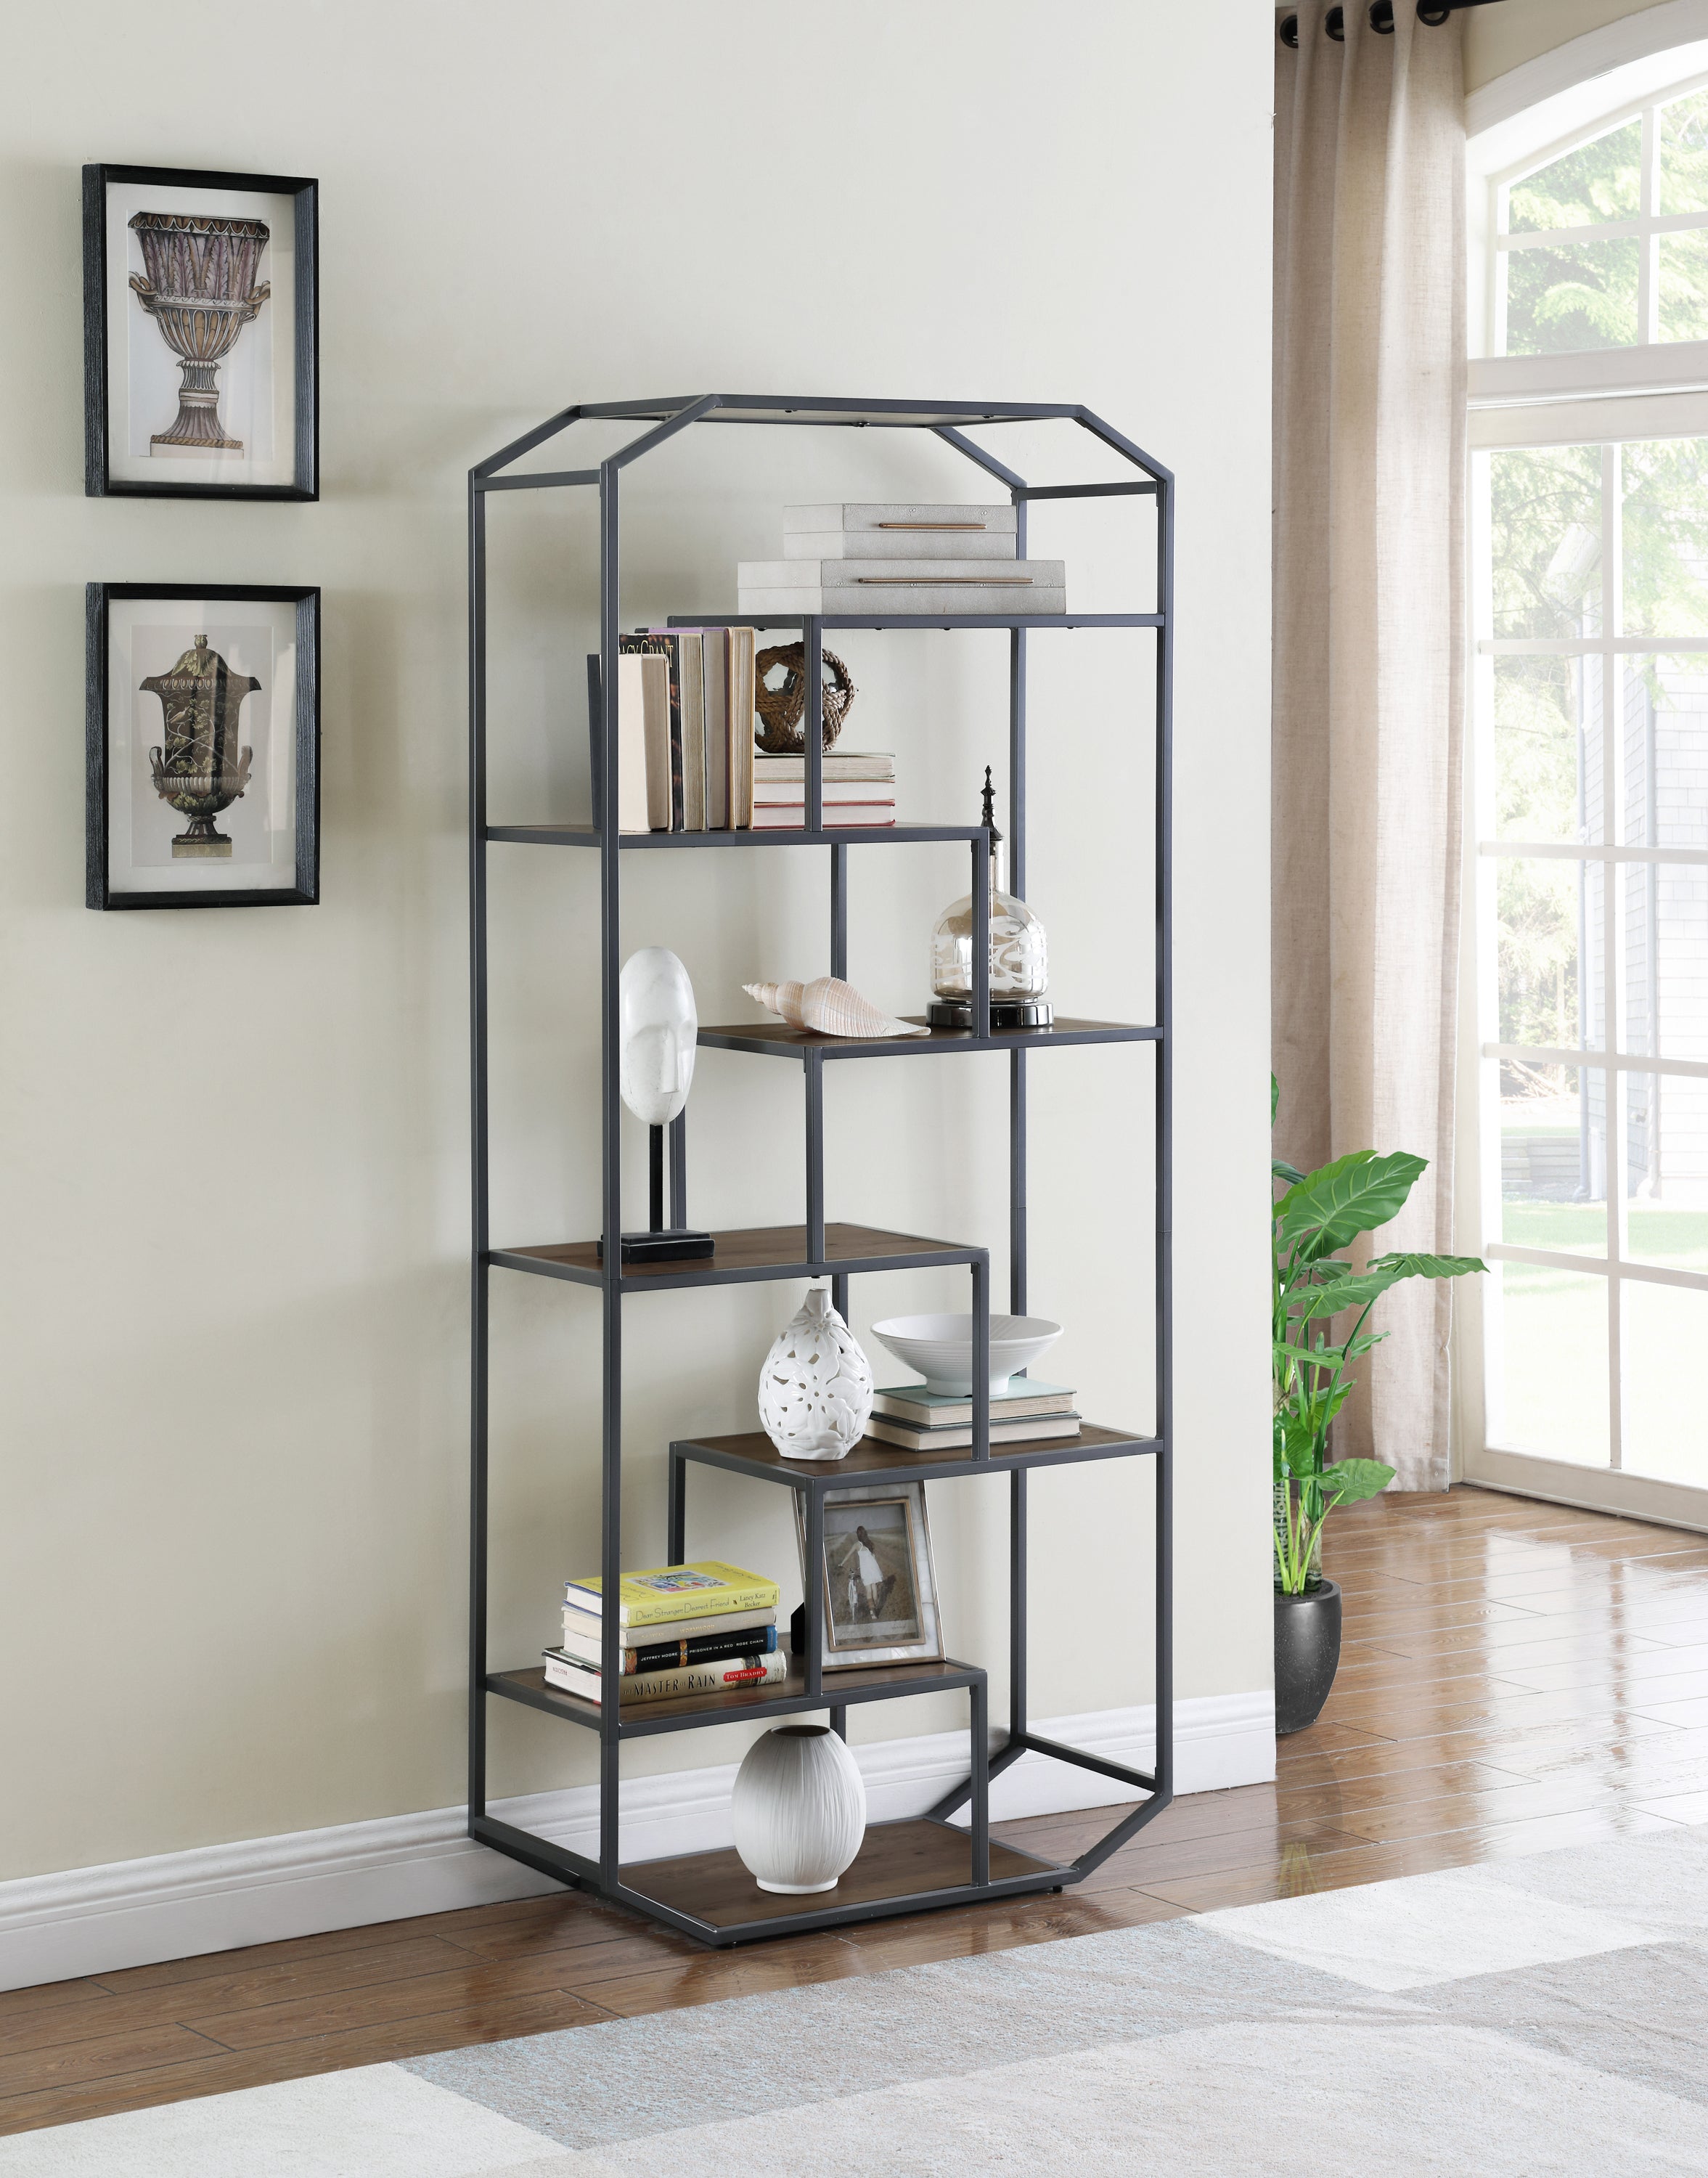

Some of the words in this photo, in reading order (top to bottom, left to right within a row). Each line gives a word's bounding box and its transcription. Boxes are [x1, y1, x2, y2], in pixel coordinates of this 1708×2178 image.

[636, 1610, 653, 1621] Dear
[685, 1602, 708, 1613] Dearest
[710, 1597, 730, 1610] Friend
[634, 1679, 679, 1697] MASTER
[688, 1674, 716, 1690] RAIN
